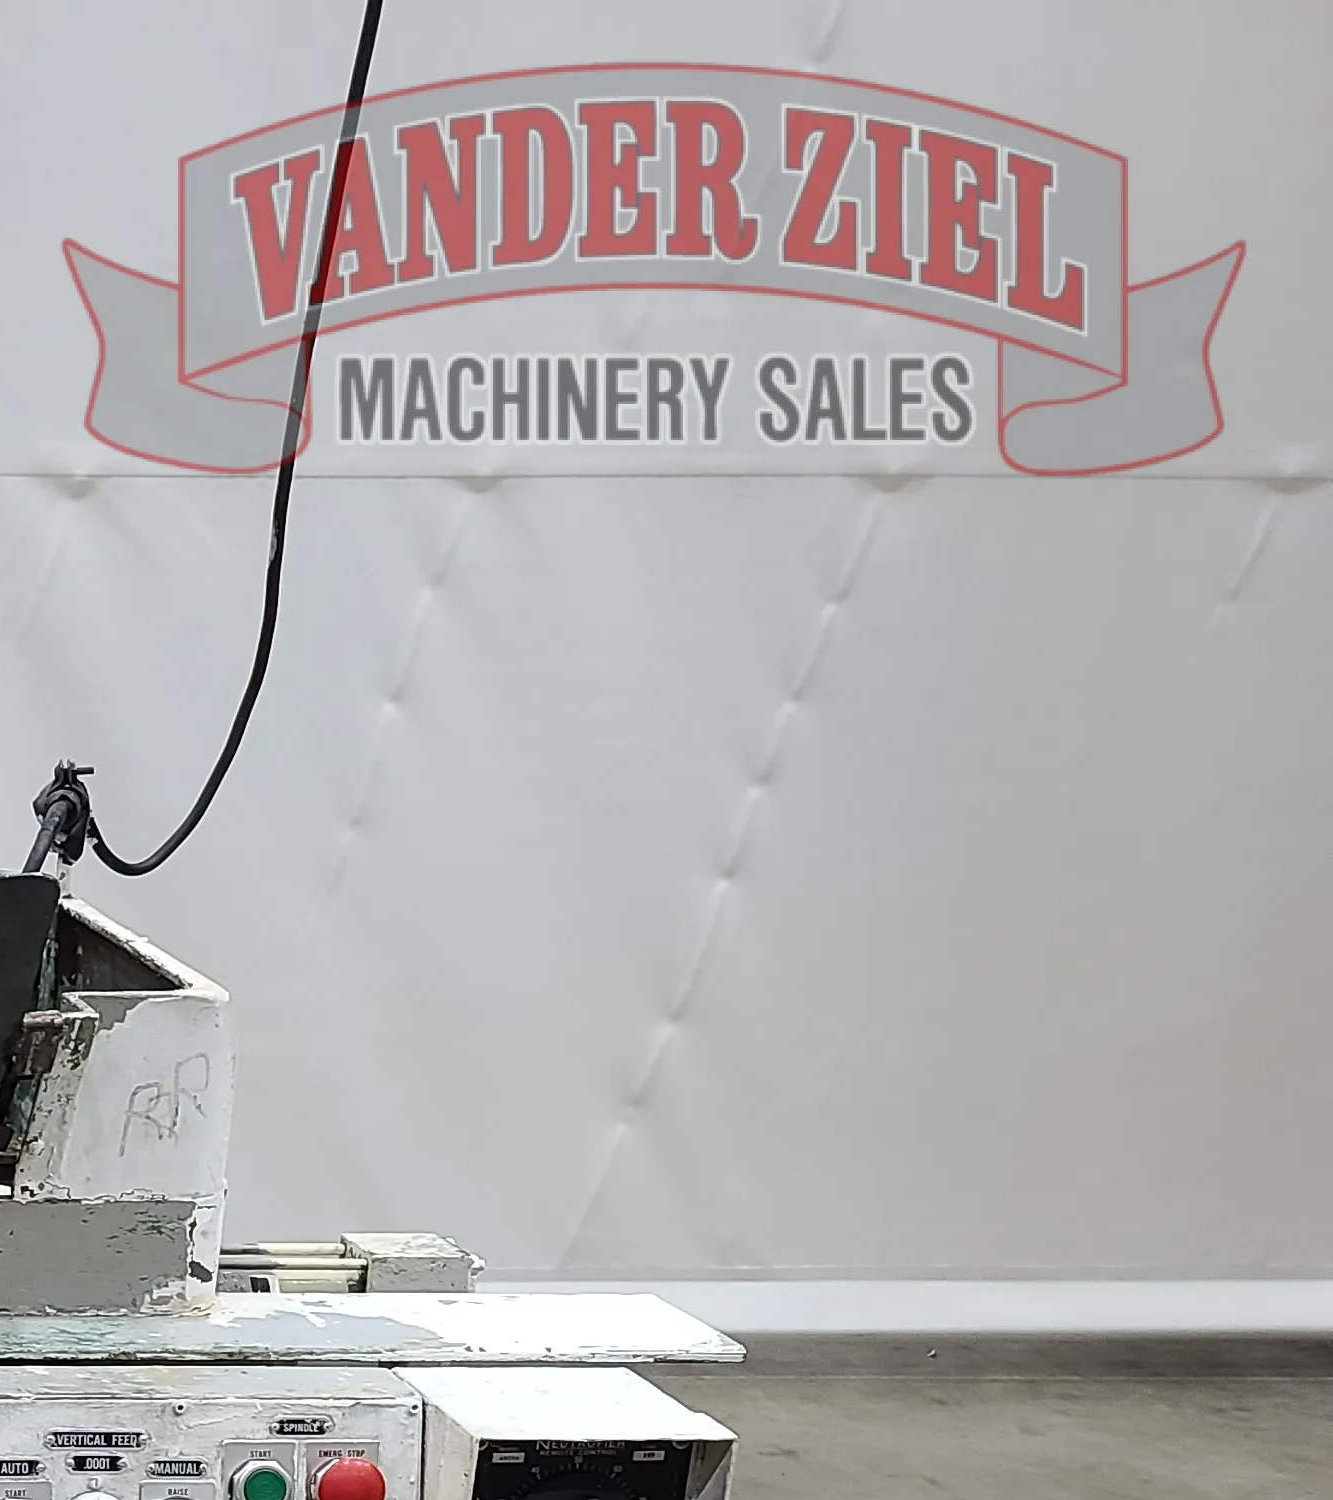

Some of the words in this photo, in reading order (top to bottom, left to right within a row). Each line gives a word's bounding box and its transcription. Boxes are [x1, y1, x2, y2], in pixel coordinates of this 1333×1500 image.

[283, 1423, 320, 1432] SPINDLE
[56, 1434, 107, 1446] VERTICAL
[111, 1435, 137, 1446] FEED
[1, 1463, 29, 1474] AUTO
[84, 1457, 110, 1470] .0001
[155, 1463, 199, 1474] MANUAL
[5, 1489, 26, 1497] START
[167, 1488, 189, 1496] RAISE
